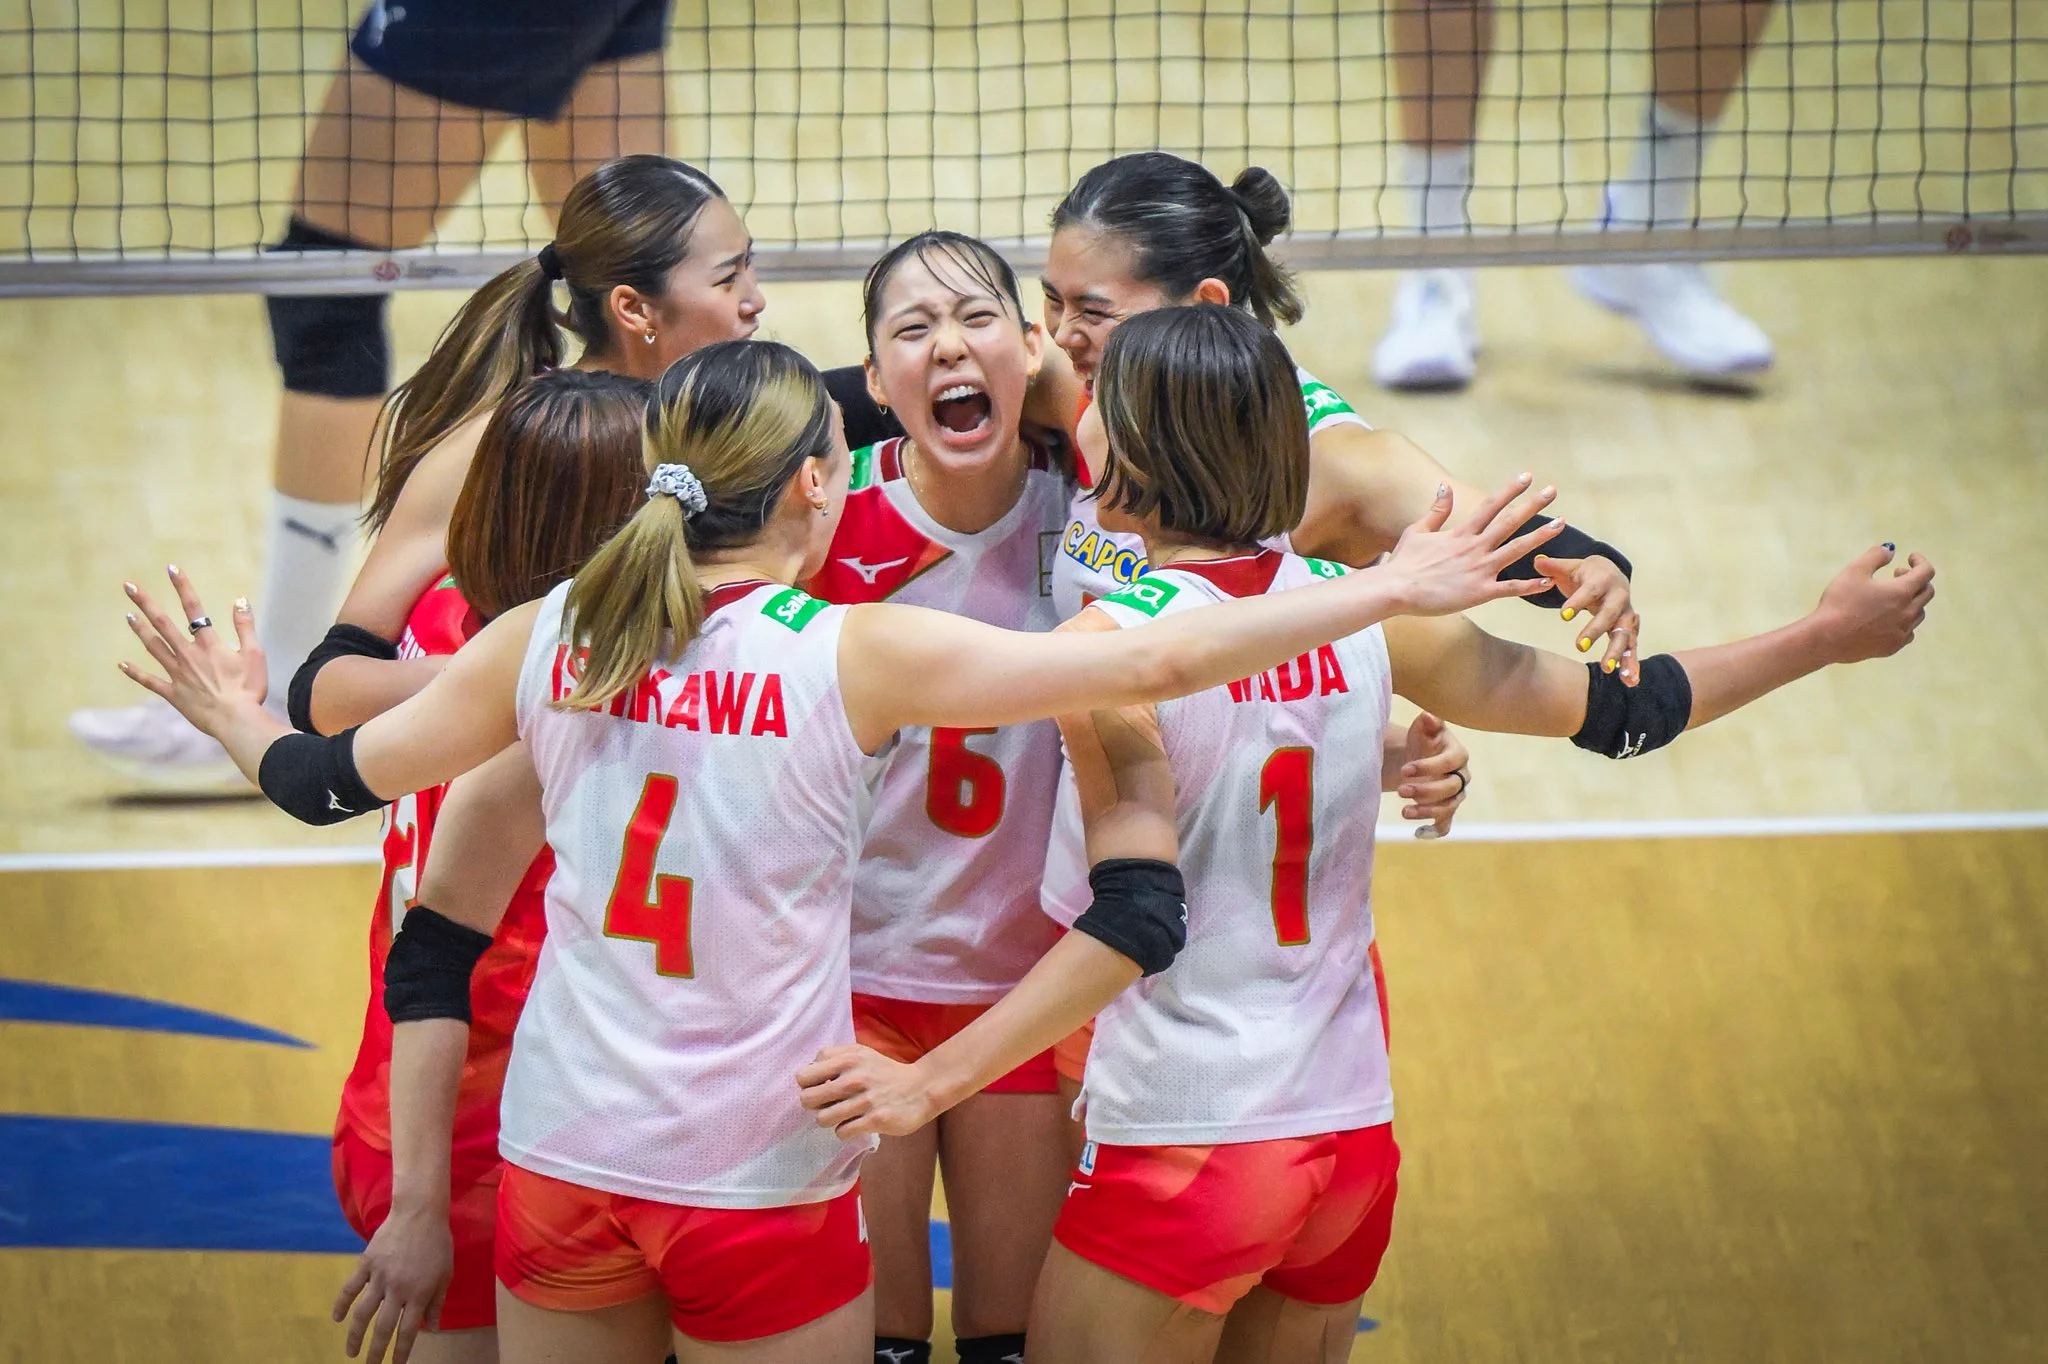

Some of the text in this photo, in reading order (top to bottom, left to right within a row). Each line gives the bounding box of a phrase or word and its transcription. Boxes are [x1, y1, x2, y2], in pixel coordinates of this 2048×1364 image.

[603, 772, 694, 979] 4
[926, 726, 1006, 839] 6
[1257, 746, 1314, 946] 1
